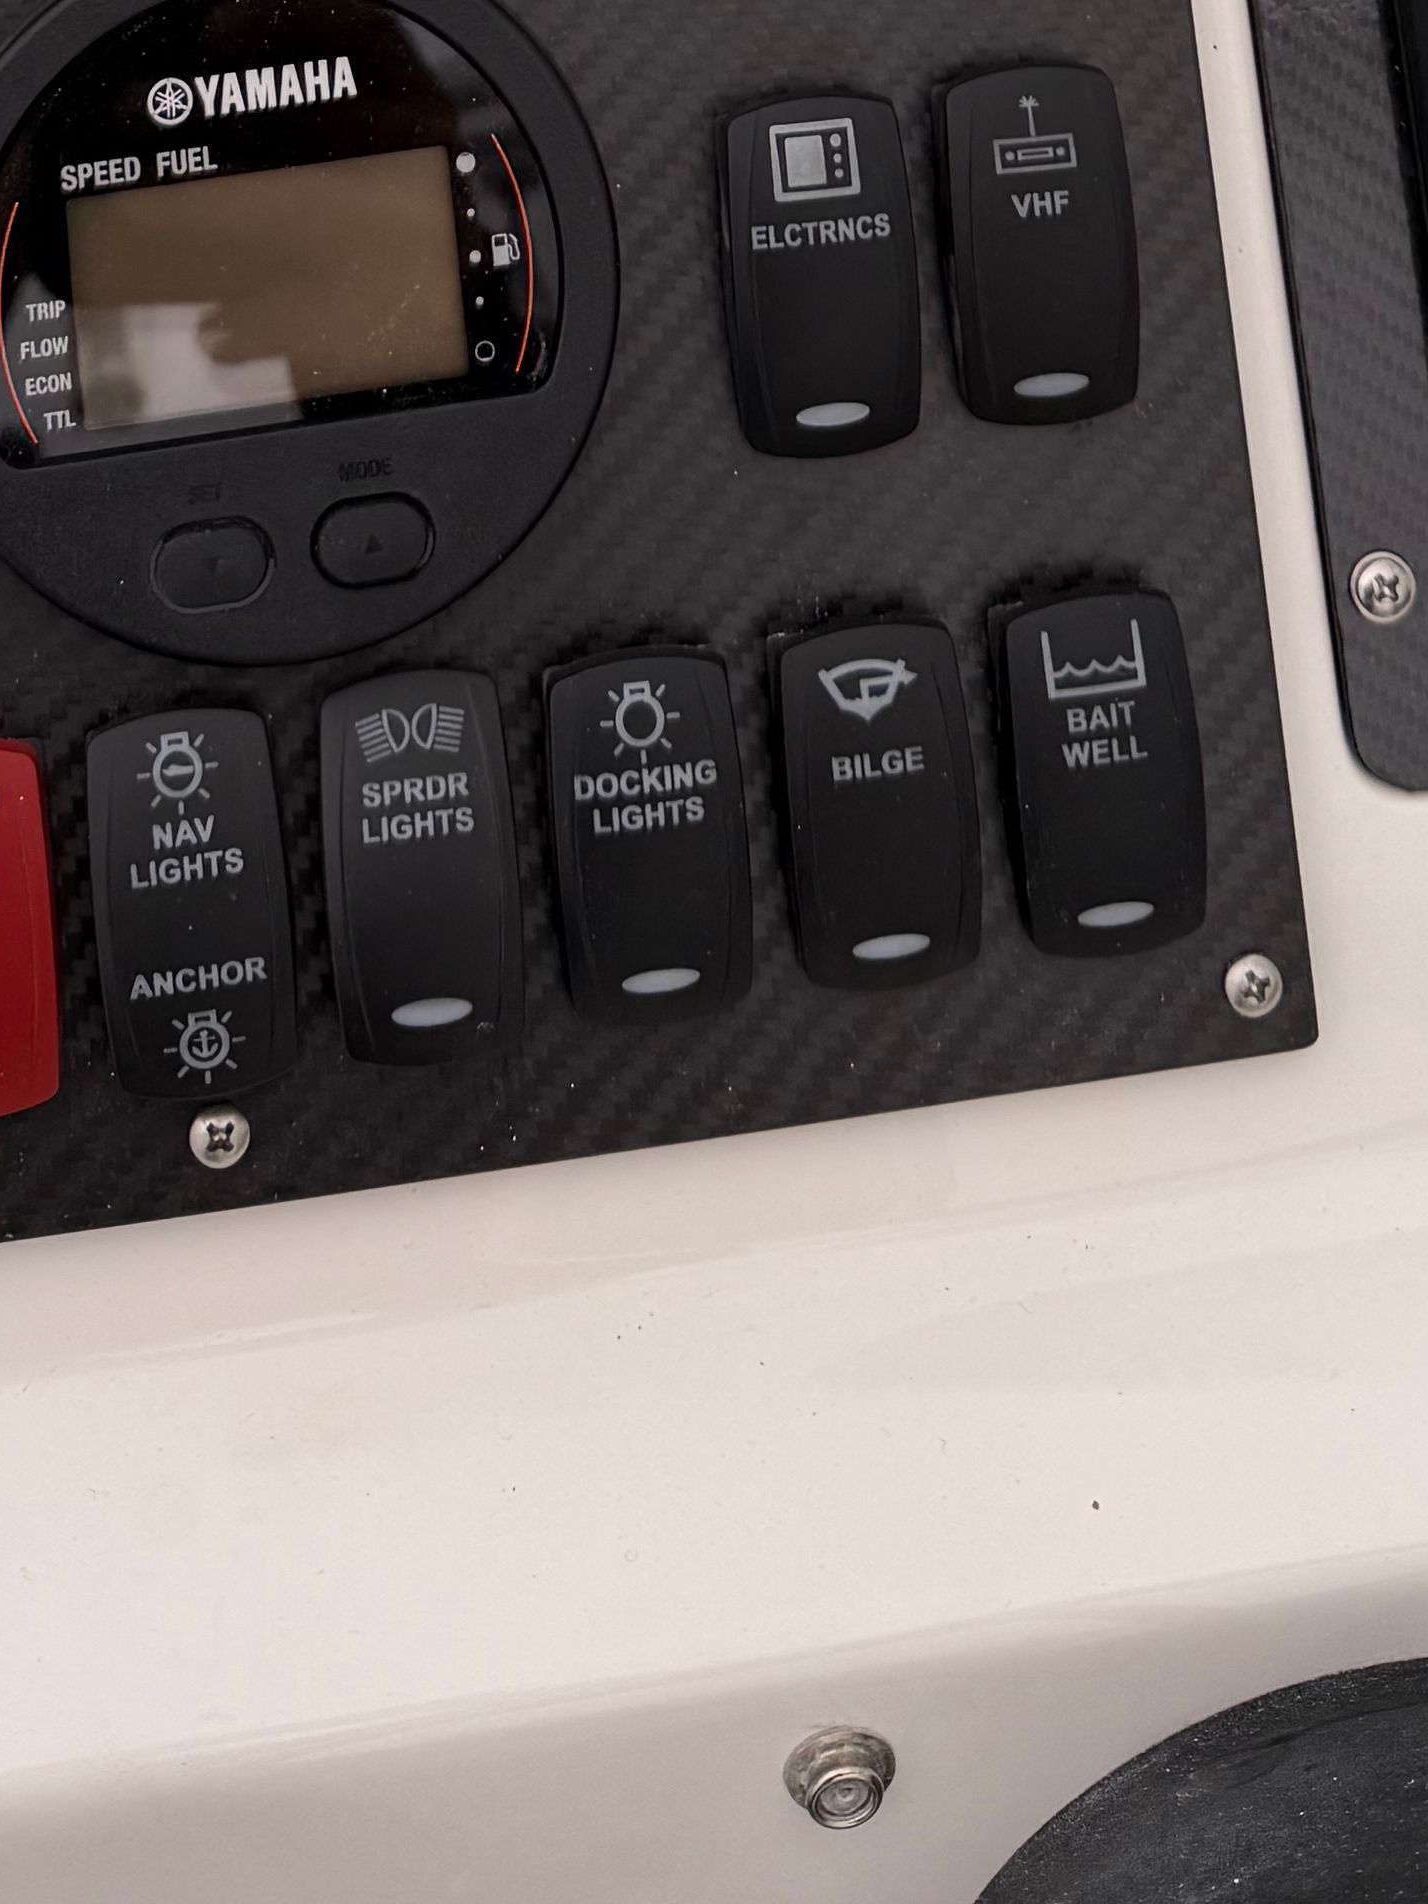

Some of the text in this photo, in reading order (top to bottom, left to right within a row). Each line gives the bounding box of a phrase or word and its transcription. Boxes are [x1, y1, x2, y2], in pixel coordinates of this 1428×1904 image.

[194, 56, 358, 120] YAMAHA
[60, 145, 218, 192] SPEED FUEL
[1012, 190, 1070, 219] VHF
[751, 213, 891, 251] ELCTRNCS
[26, 299, 66, 322] TRIP
[20, 336, 68, 360] FLOW
[25, 372, 72, 396] ECON
[43, 409, 76, 431] TTL
[338, 458, 393, 483] MODE
[1066, 701, 1136, 735] BAIT
[831, 745, 925, 784] BILGE
[1062, 735, 1148, 771] WELL
[362, 773, 469, 809] SPRDR
[573, 759, 718, 802] DOCKING
[152, 816, 215, 851] NAV
[362, 807, 475, 845] LIGHTS
[592, 796, 705, 836] LIGHTS
[129, 847, 244, 890] LIGHTS
[129, 956, 268, 1002] ANCHOR
